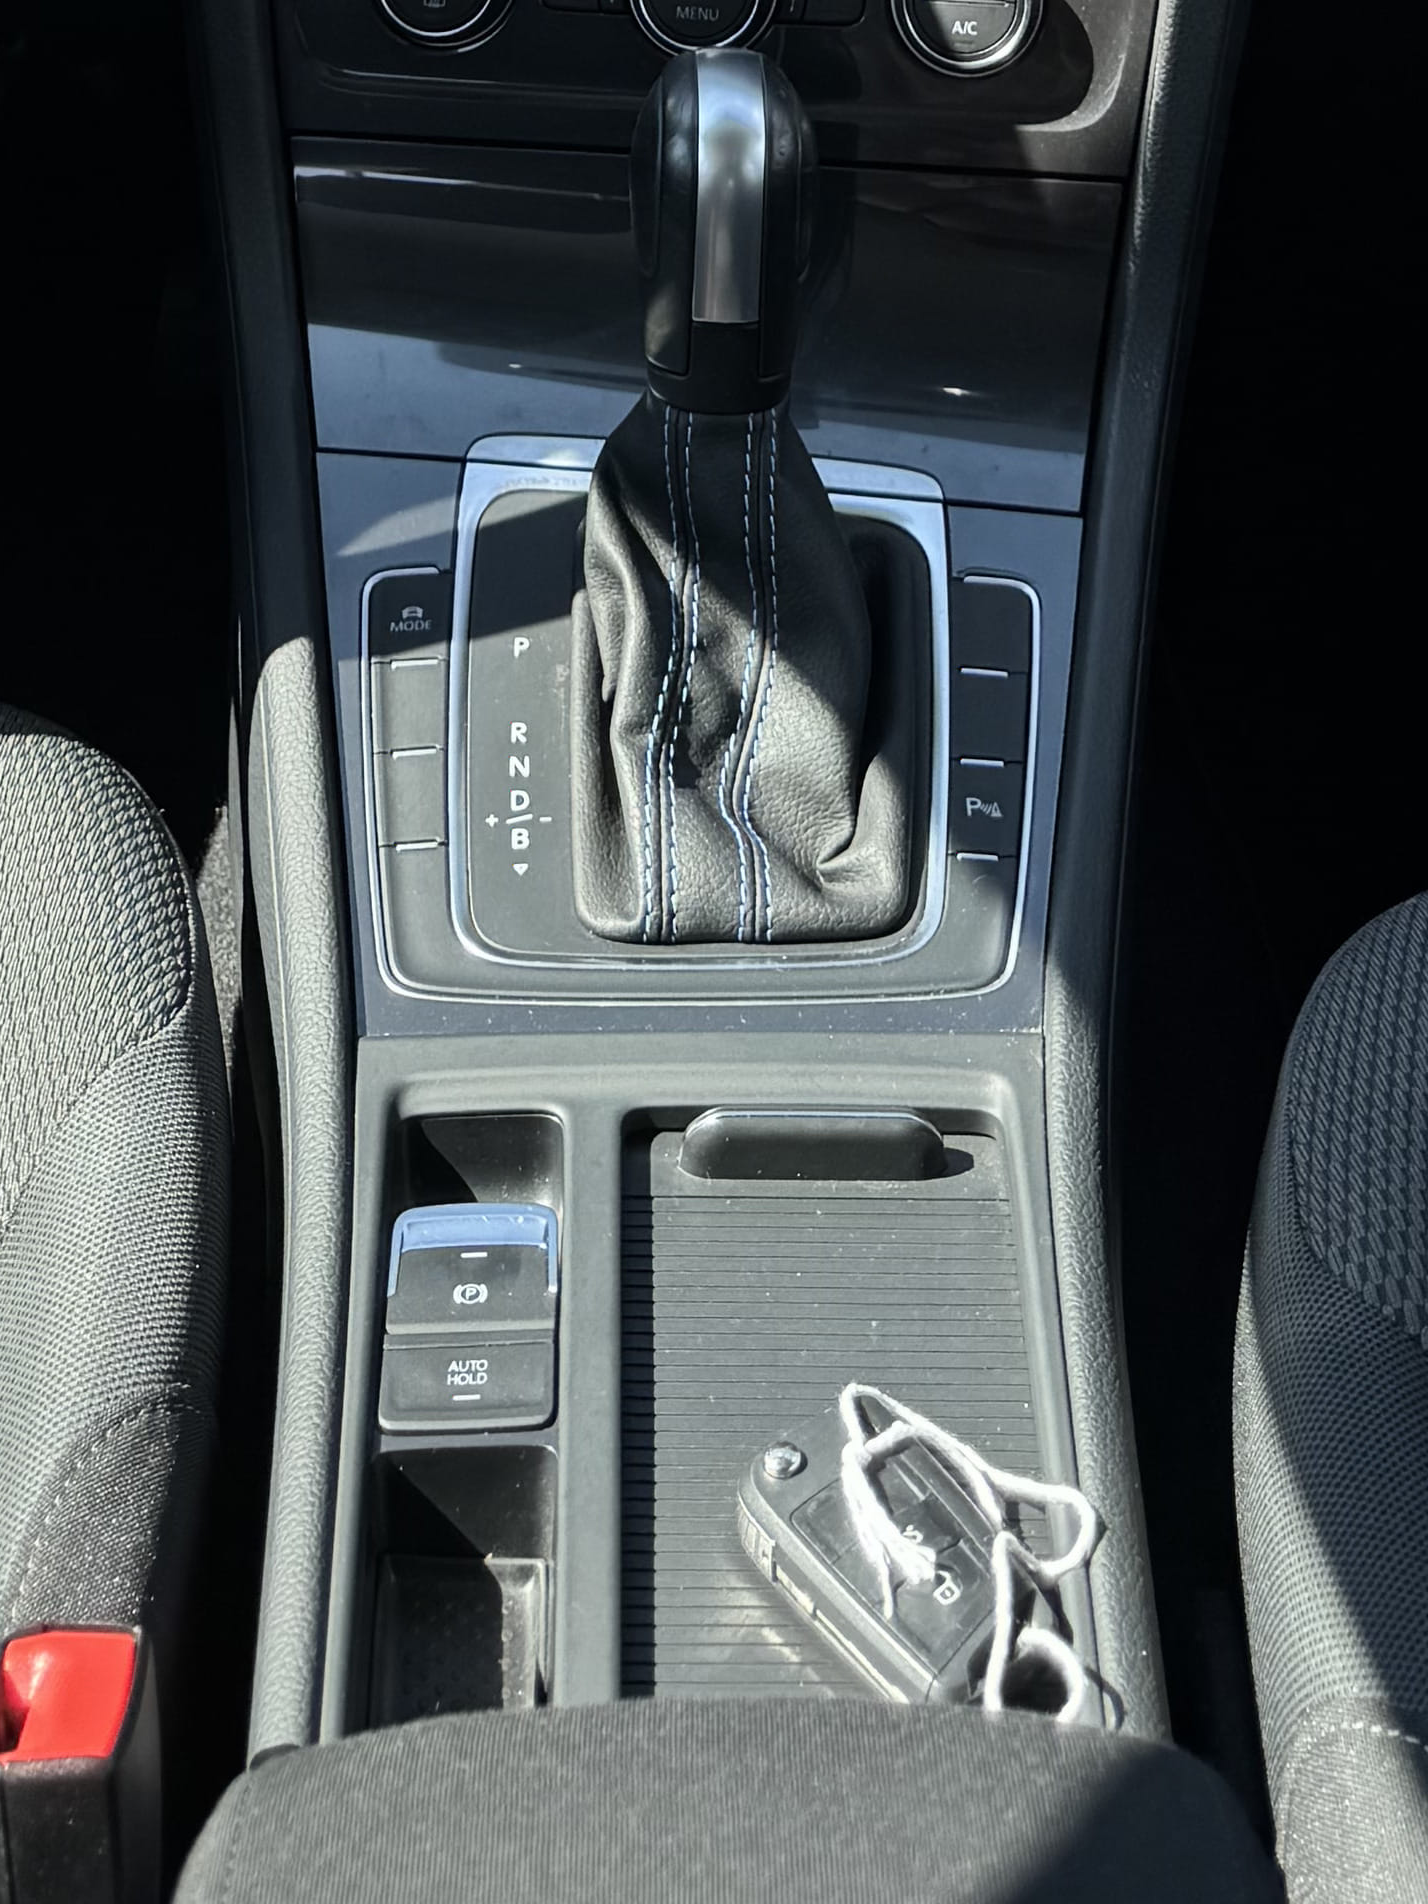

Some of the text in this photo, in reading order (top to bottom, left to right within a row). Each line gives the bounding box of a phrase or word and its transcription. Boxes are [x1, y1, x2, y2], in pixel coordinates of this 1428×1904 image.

[676, 6, 720, 21] MENU
[952, 20, 978, 35] A/C
[390, 619, 432, 632] MODE
[513, 636, 530, 658] P
[510, 722, 528, 743] R
[508, 755, 531, 778] N
[510, 789, 531, 811] D
[511, 828, 530, 850] B
[448, 1359, 489, 1372] AUTO
[447, 1373, 488, 1385] HOLD
